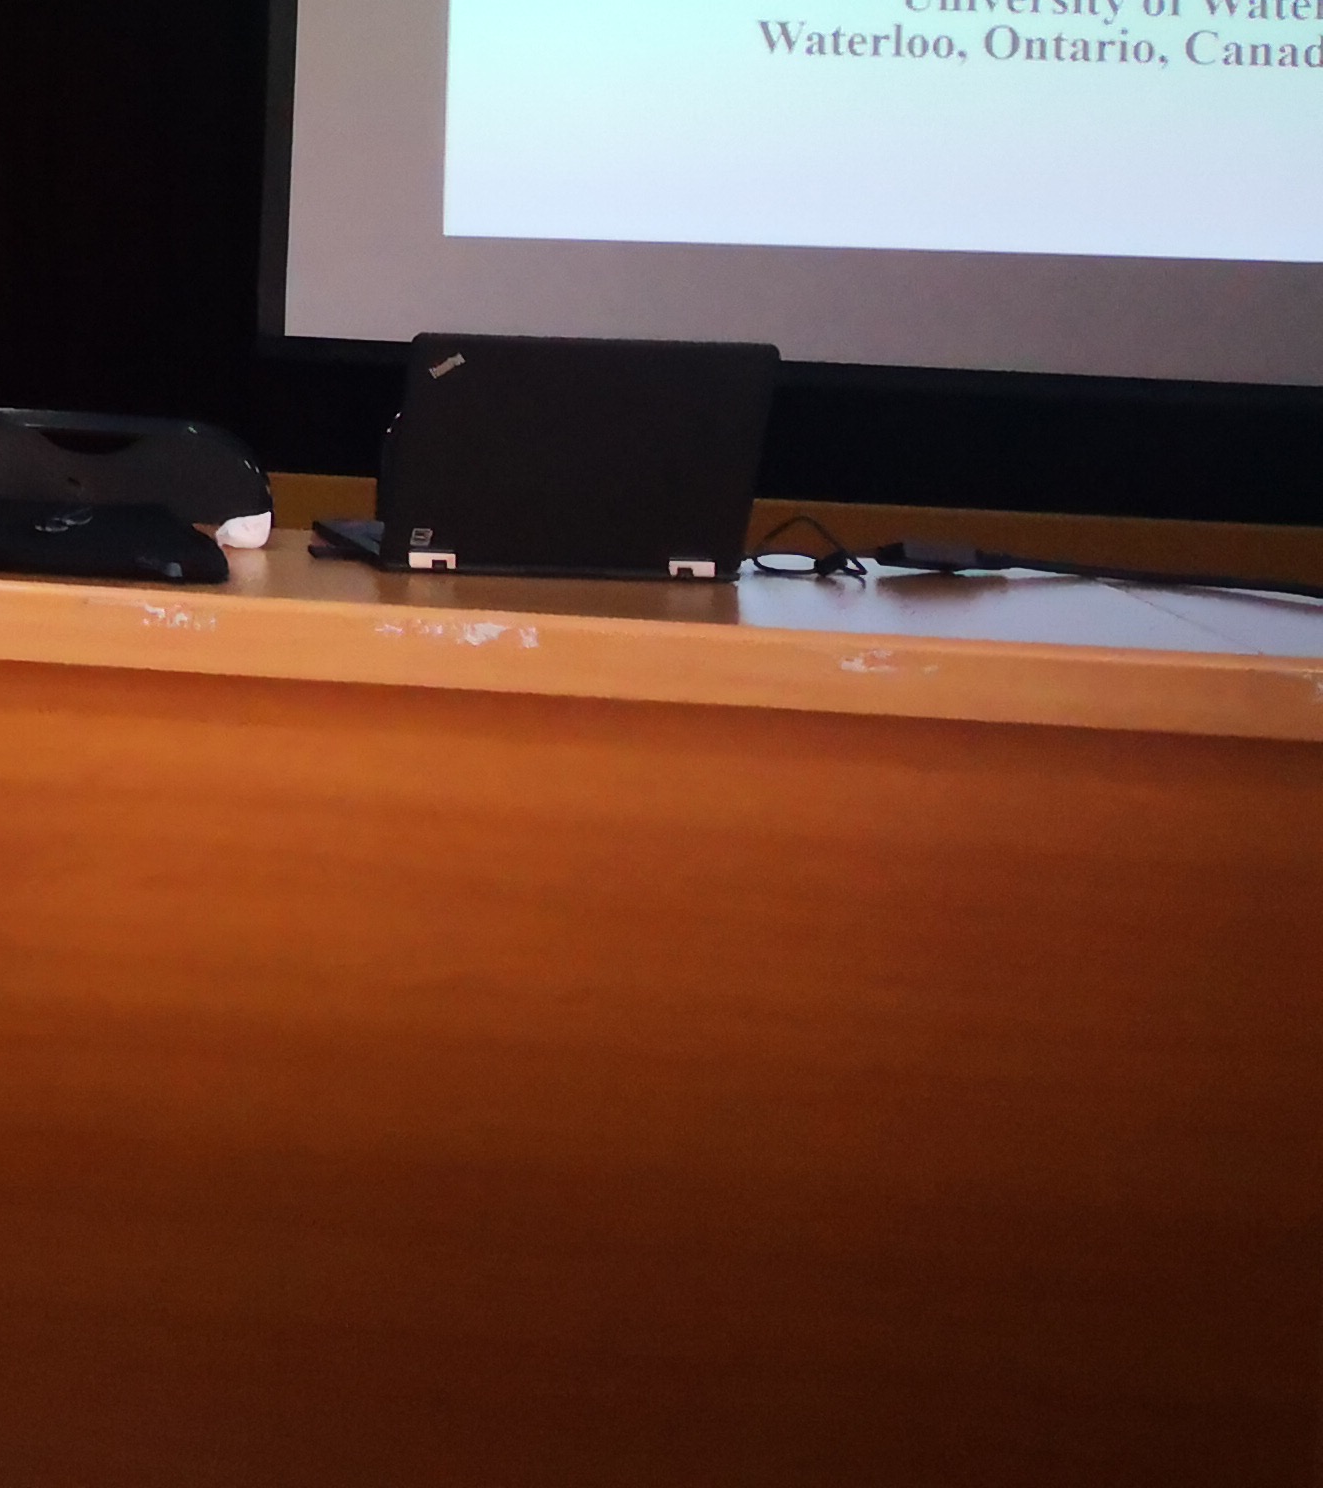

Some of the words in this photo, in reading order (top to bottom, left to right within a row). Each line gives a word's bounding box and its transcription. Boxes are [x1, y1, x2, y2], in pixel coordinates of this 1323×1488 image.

[758, 20, 968, 63] Waterloo,
[983, 24, 1170, 70] Ontario,
[1185, 29, 1323, 69] Canad
